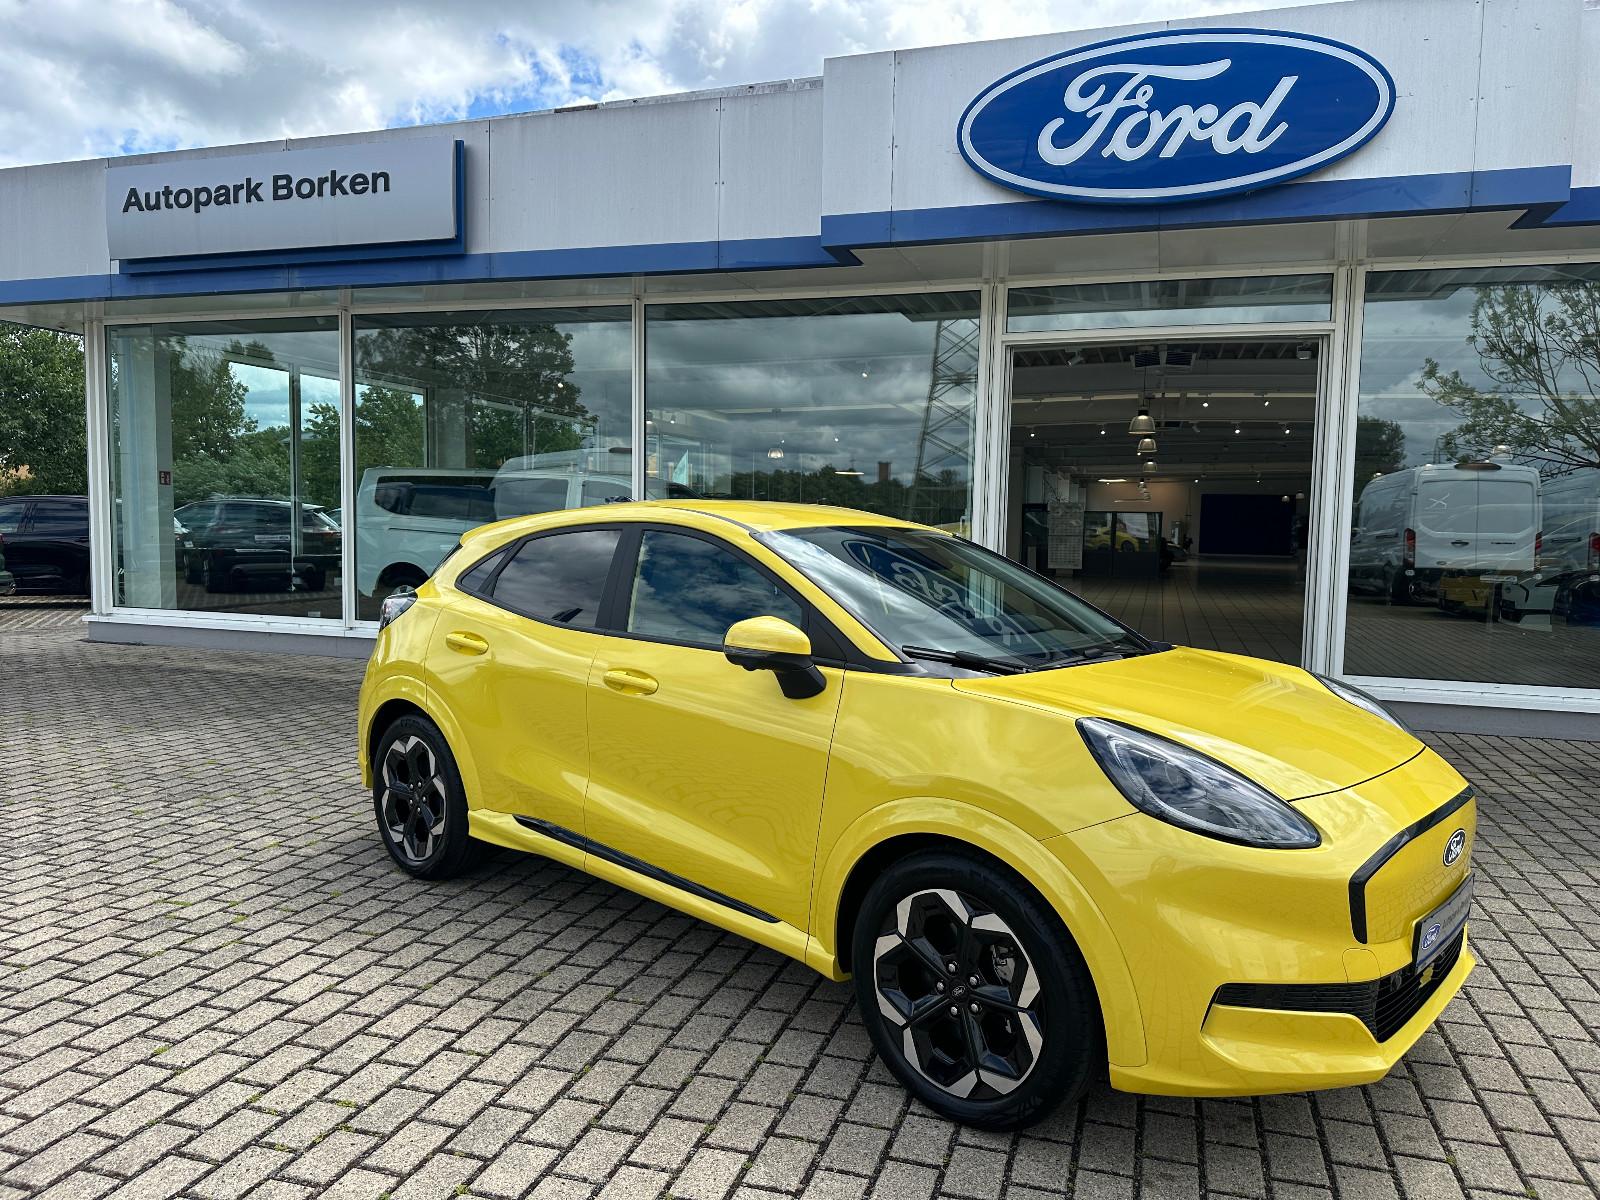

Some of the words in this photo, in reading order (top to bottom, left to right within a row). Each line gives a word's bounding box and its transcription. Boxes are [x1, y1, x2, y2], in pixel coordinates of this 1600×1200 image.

[1038, 59, 1299, 165] Ford
[122, 177, 264, 213] Autopark
[272, 170, 390, 201] Borken
